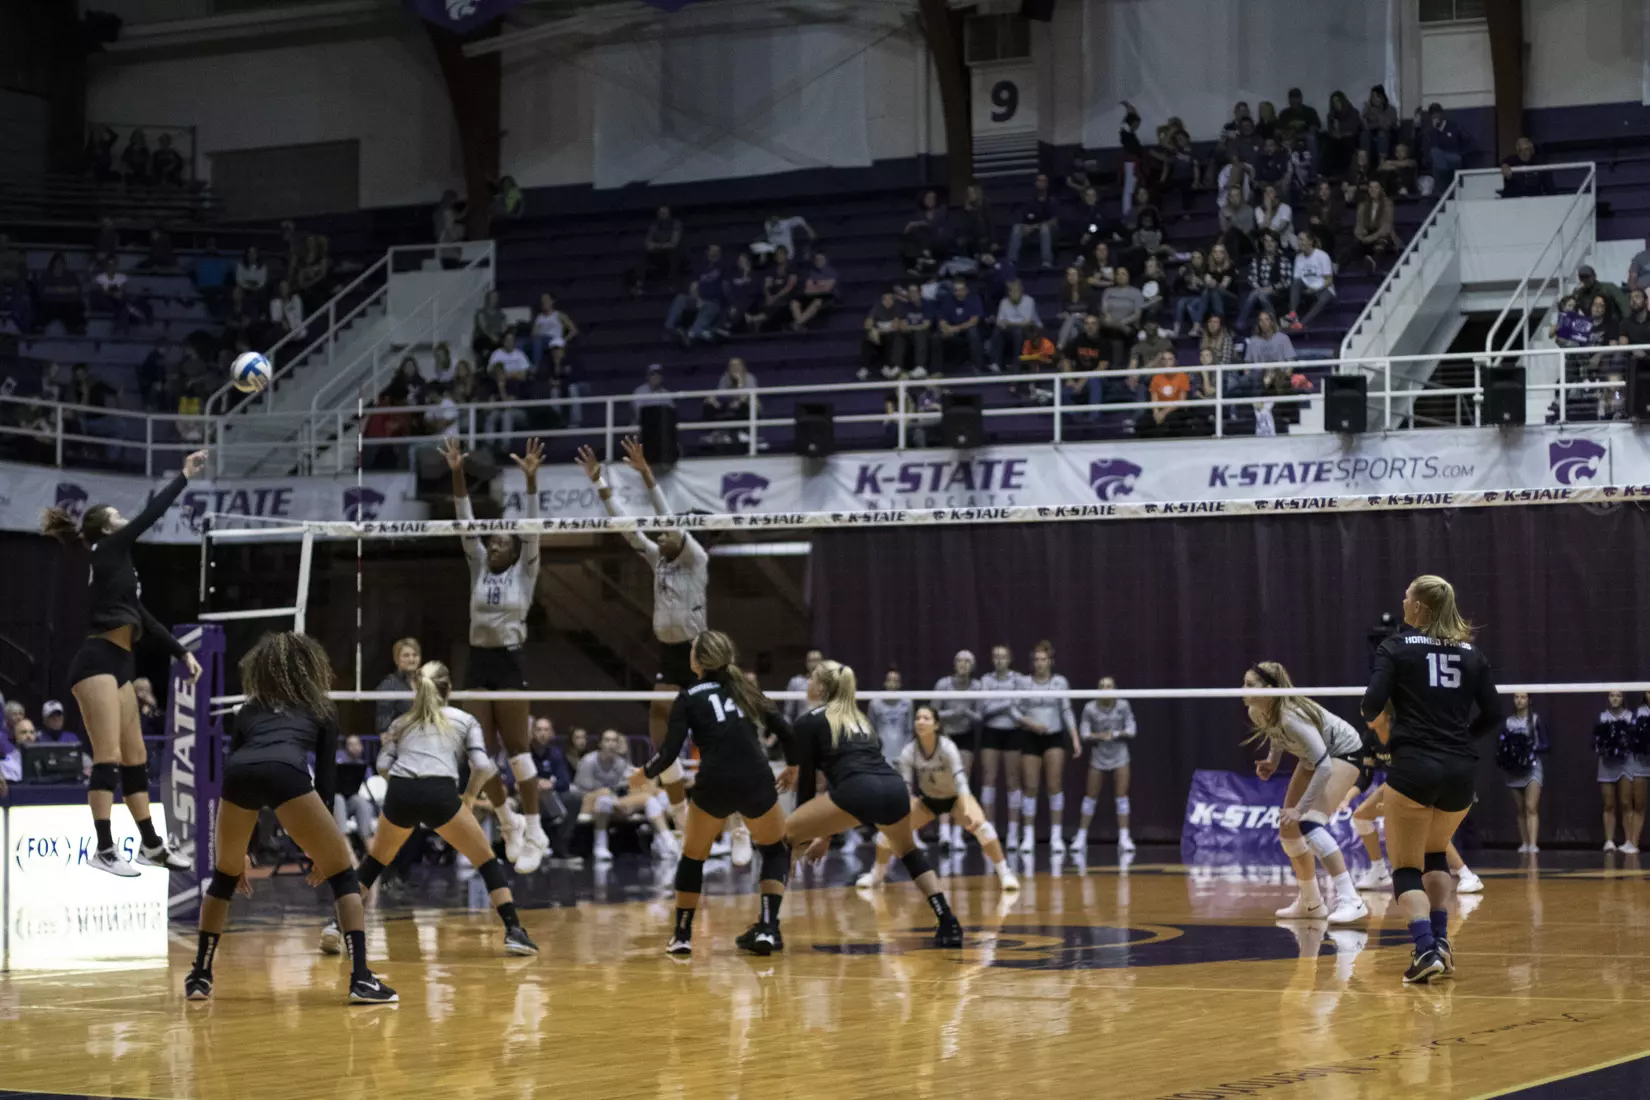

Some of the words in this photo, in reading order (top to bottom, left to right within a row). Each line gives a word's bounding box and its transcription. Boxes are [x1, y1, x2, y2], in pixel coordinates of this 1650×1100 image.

[991, 81, 1019, 122] 9
[854, 458, 1028, 495] K-STATE
[378, 522, 428, 533] K-STATE
[467, 520, 518, 531] K-STATE
[558, 518, 611, 529] K-STATE
[652, 516, 706, 528] K-STATE
[749, 514, 804, 526] K-STATE
[848, 511, 905, 523] K-STATE
[951, 508, 1010, 520] K-STATE
[1055, 504, 1116, 517] K-STATE
[1163, 501, 1225, 513] K-STATE
[1273, 497, 1338, 510] K-STATE
[1387, 491, 1453, 505] K-STATE
[1504, 487, 1572, 500] K-STATE
[1426, 652, 1461, 688] 15
[708, 693, 744, 722] 14
